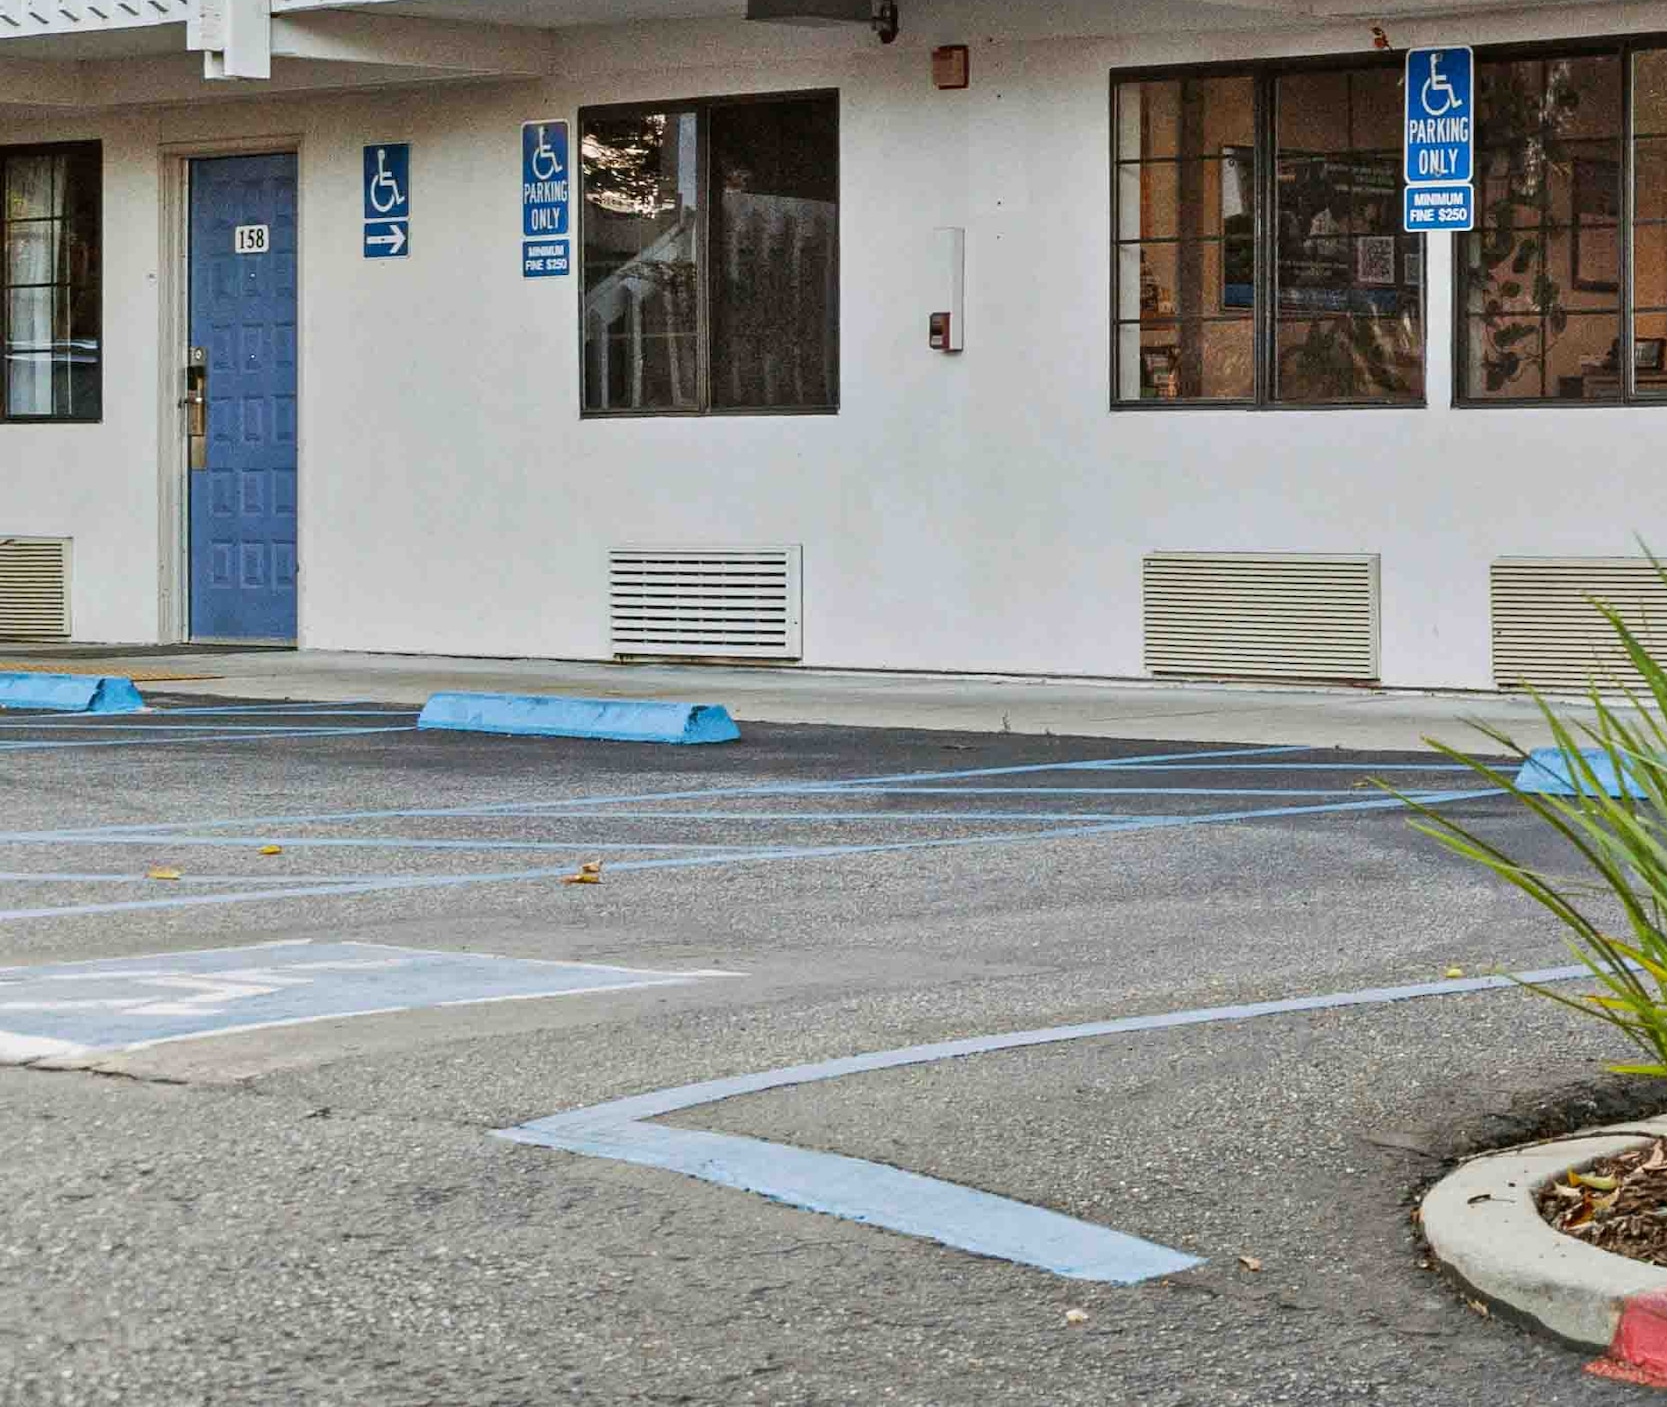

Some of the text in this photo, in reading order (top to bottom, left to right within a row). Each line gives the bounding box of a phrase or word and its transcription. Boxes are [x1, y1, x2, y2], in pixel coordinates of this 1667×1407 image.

[1409, 117, 1469, 144] PARKING
[1419, 148, 1458, 175] ONLY
[524, 180, 568, 204] PARKING
[1414, 192, 1463, 206] MINIMUM
[531, 207, 560, 231] ONLY
[1410, 208, 1468, 222] FINE $250
[240, 228, 265, 249] 158
[528, 245, 565, 257] MINIMUM
[525, 260, 544, 271] FINE
